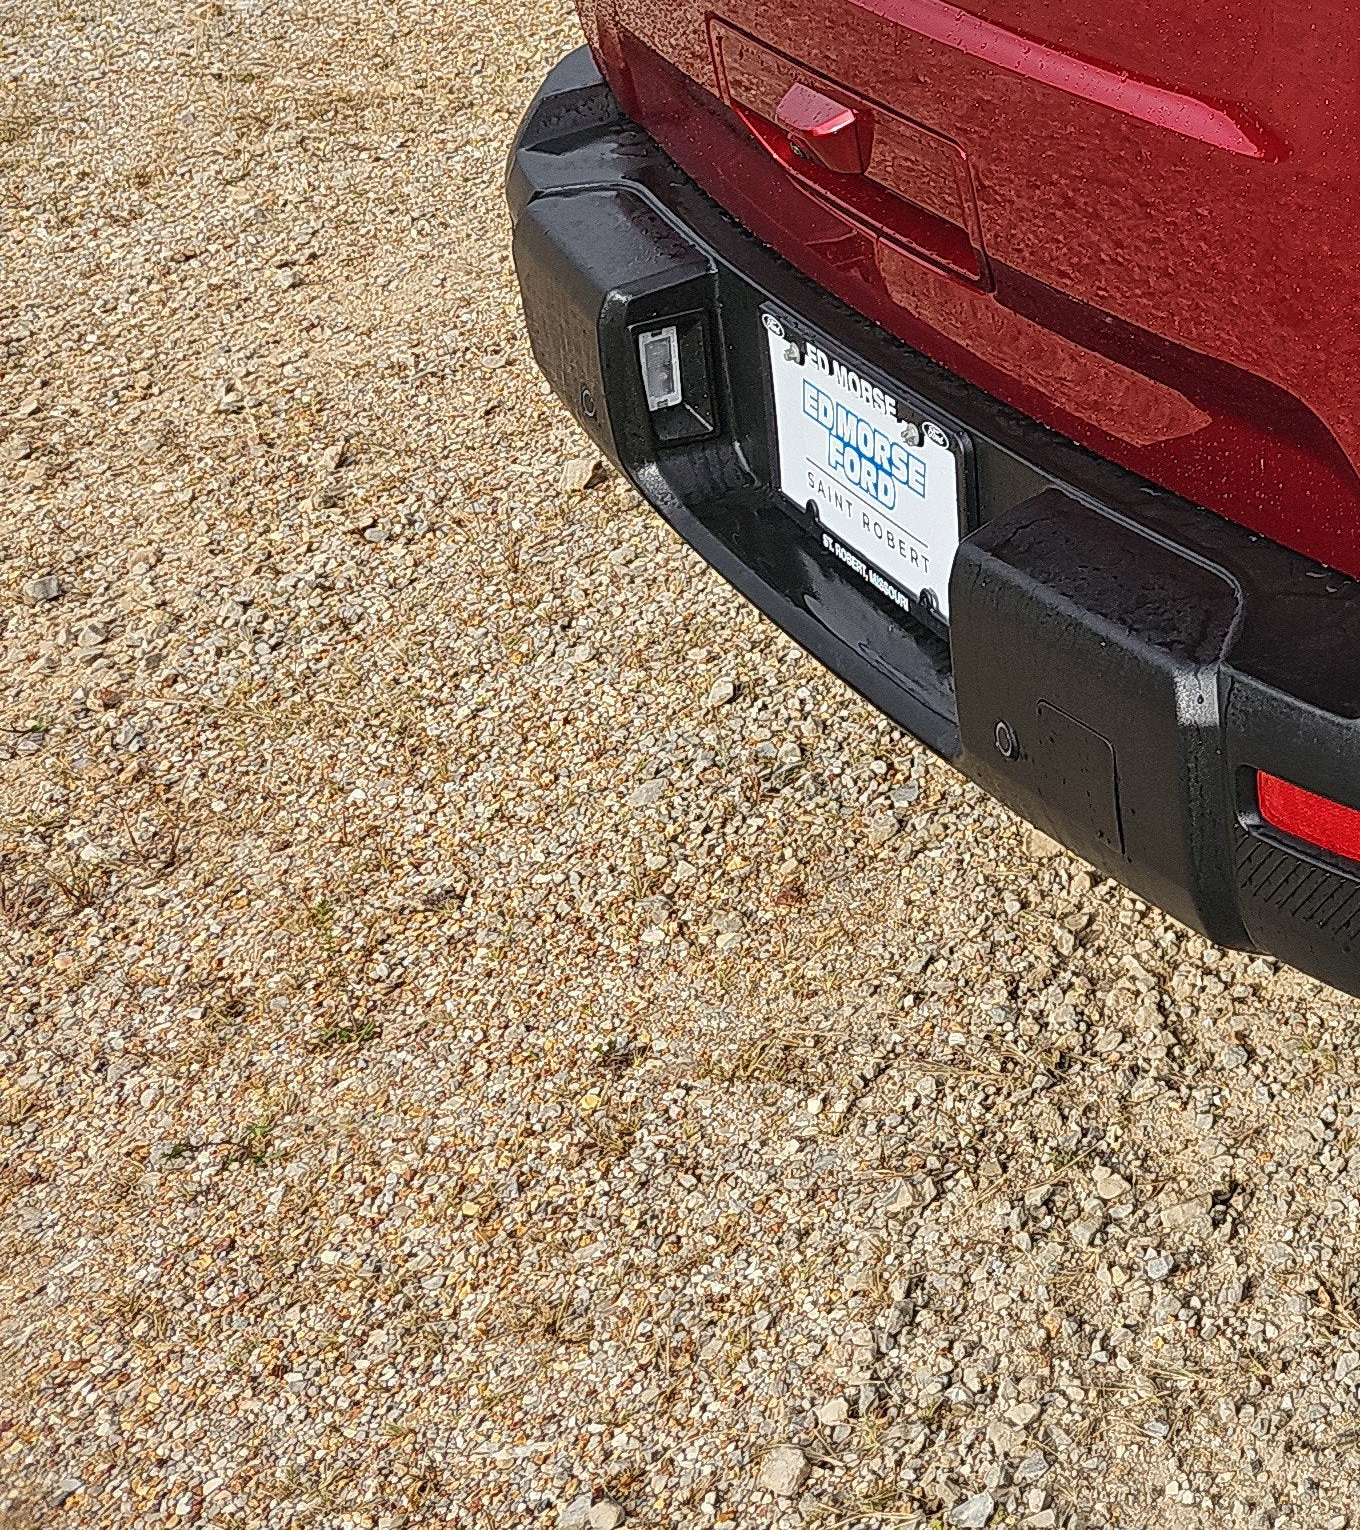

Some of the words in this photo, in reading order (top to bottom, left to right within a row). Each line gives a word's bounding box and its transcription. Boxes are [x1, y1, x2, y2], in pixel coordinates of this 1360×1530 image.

[804, 342, 830, 376] ED
[832, 359, 897, 419] MORSE
[803, 378, 835, 431] ED
[836, 400, 926, 499] MORSE
[828, 430, 896, 511] FORD
[807, 471, 853, 518] SAINT
[861, 511, 930, 574] ROBERT
[868, 569, 910, 612] MISSOURI
